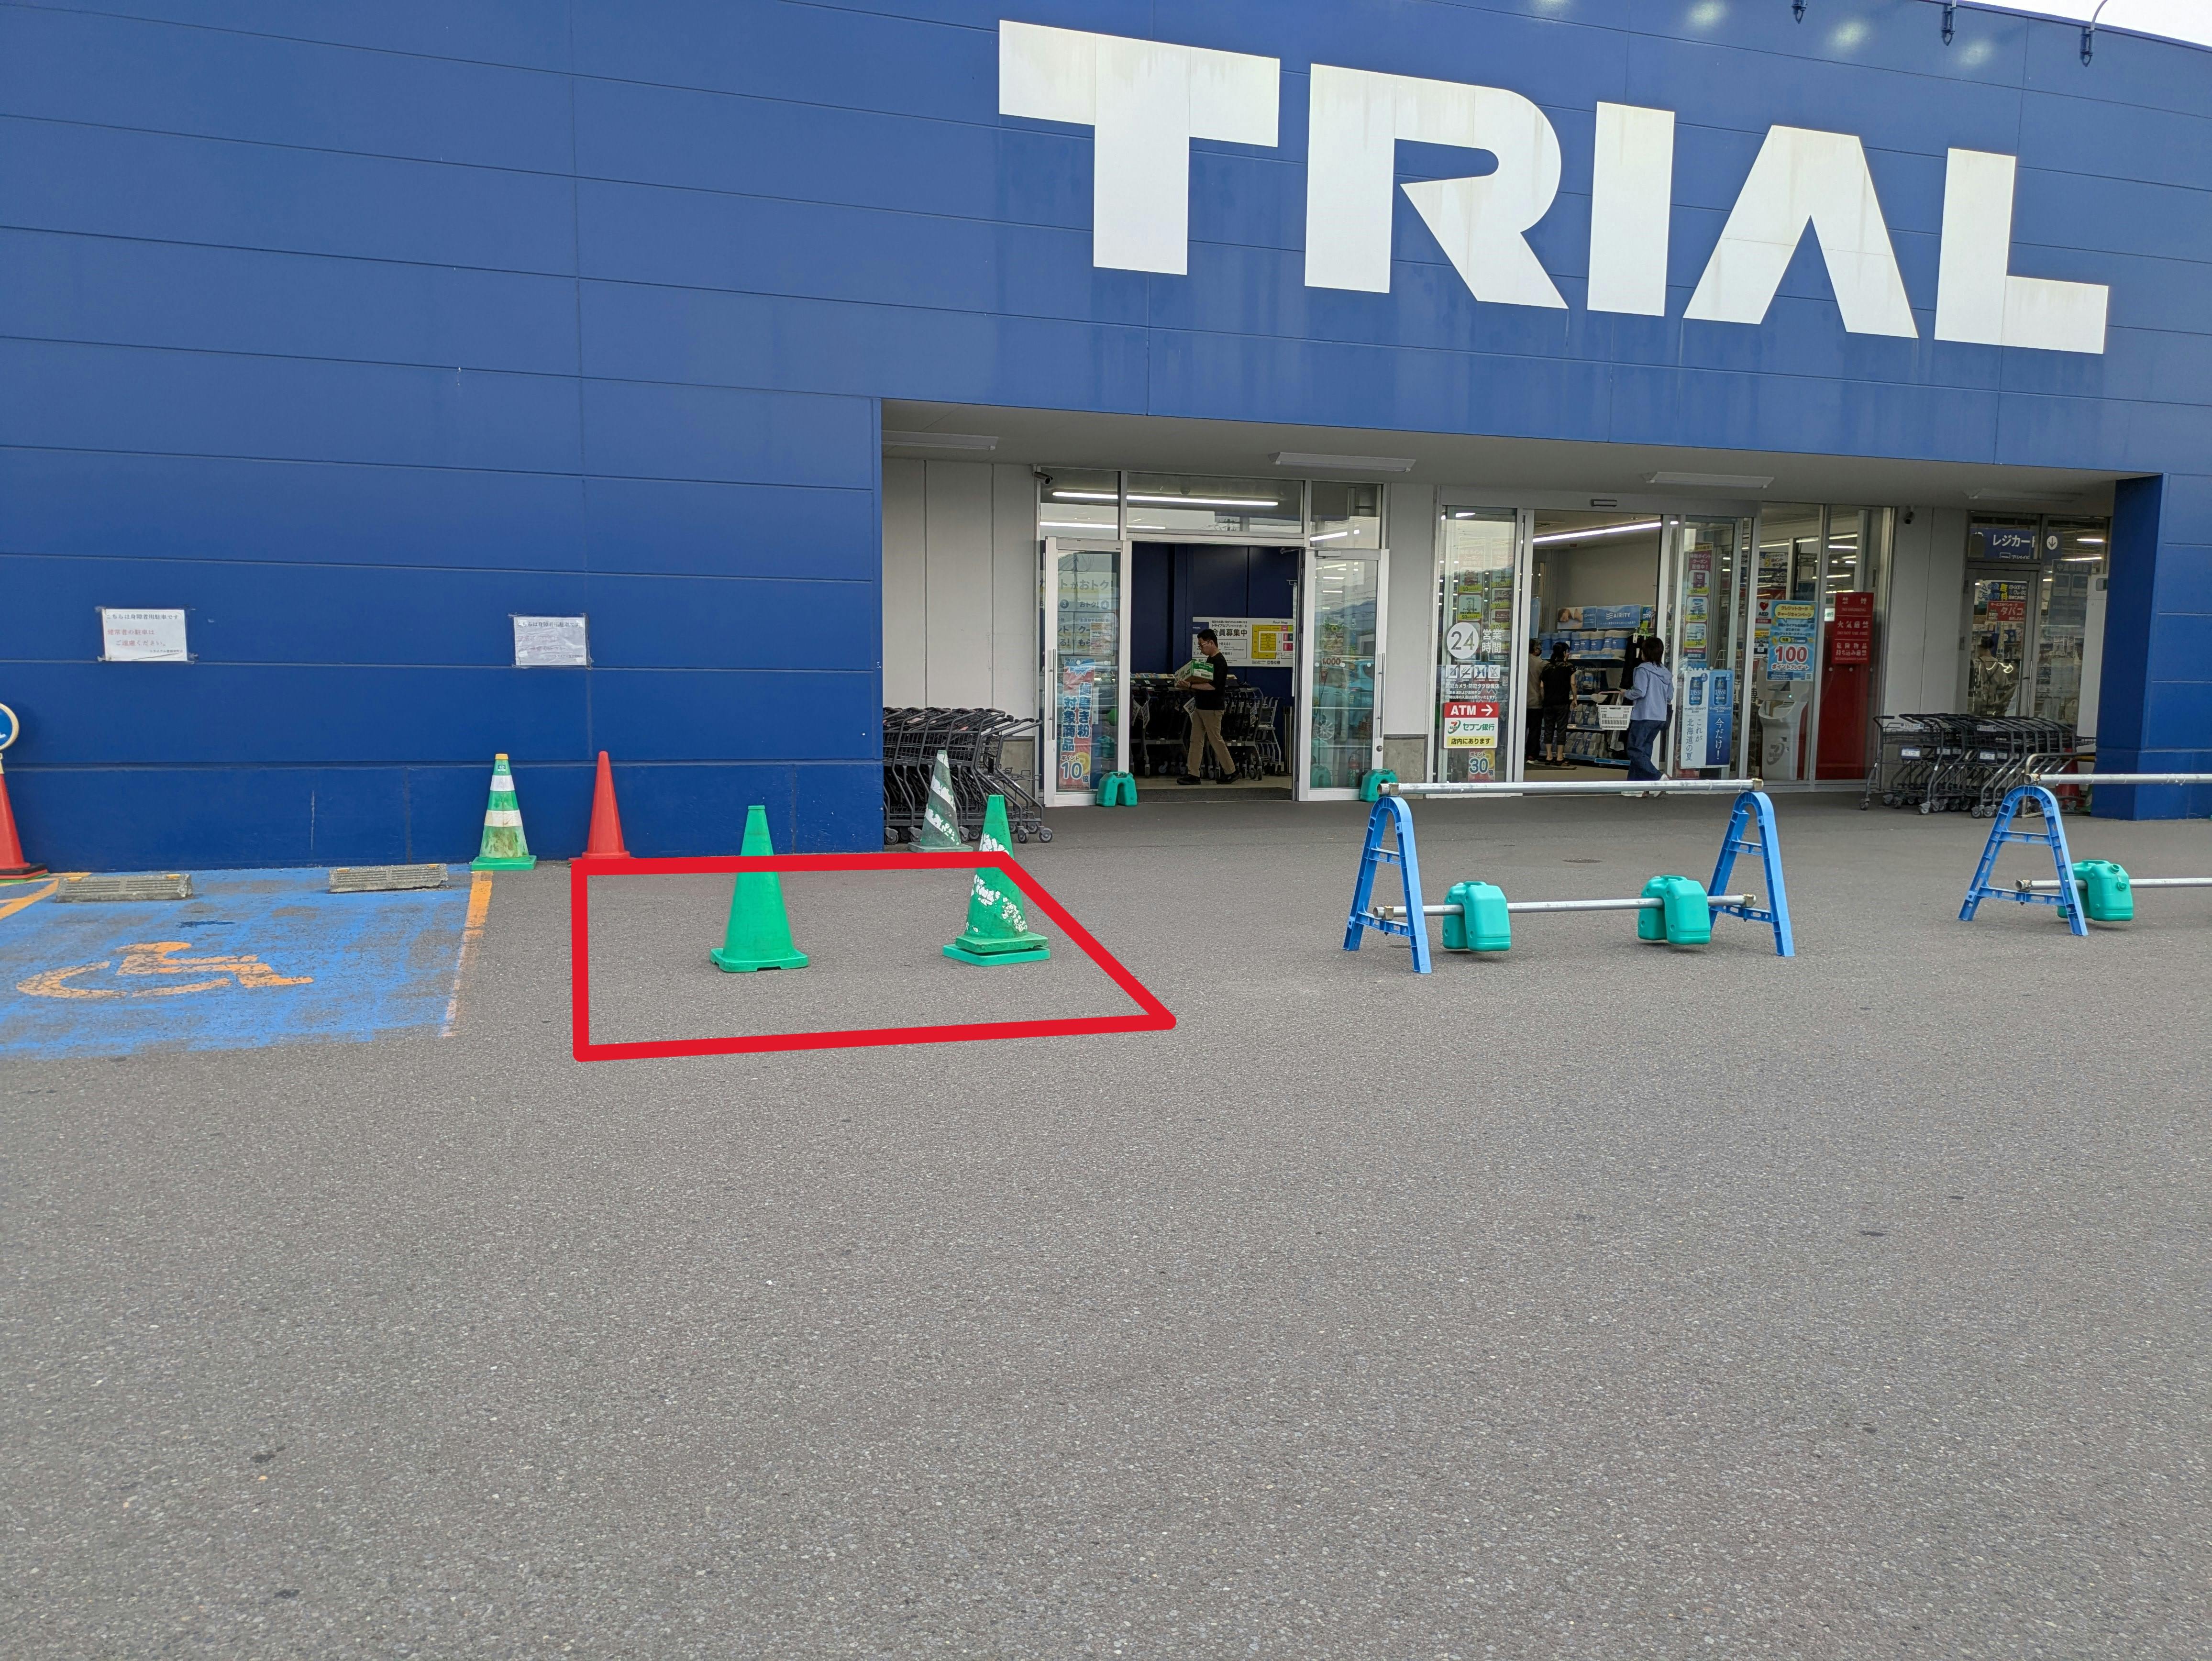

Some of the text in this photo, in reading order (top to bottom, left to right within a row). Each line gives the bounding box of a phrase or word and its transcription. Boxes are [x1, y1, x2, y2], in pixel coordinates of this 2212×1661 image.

[999, 19, 2109, 354] TRIAL
[2001, 607, 2023, 616] タバコ
[1451, 631, 1475, 650] 24
[1482, 629, 1502, 640] 営業
[1482, 642, 1502, 653] 時間
[1775, 646, 1808, 663] 100
[1450, 705, 1476, 715] ATM
[1062, 697, 1077, 752] 対象商品
[1463, 723, 1495, 731] セブン銀行
[1695, 719, 1703, 742] これが
[1685, 719, 1694, 761] 北海道の夏
[1714, 718, 1724, 759] 今だけ!
[1061, 761, 1083, 780] 10
[1470, 758, 1488, 774] 30
